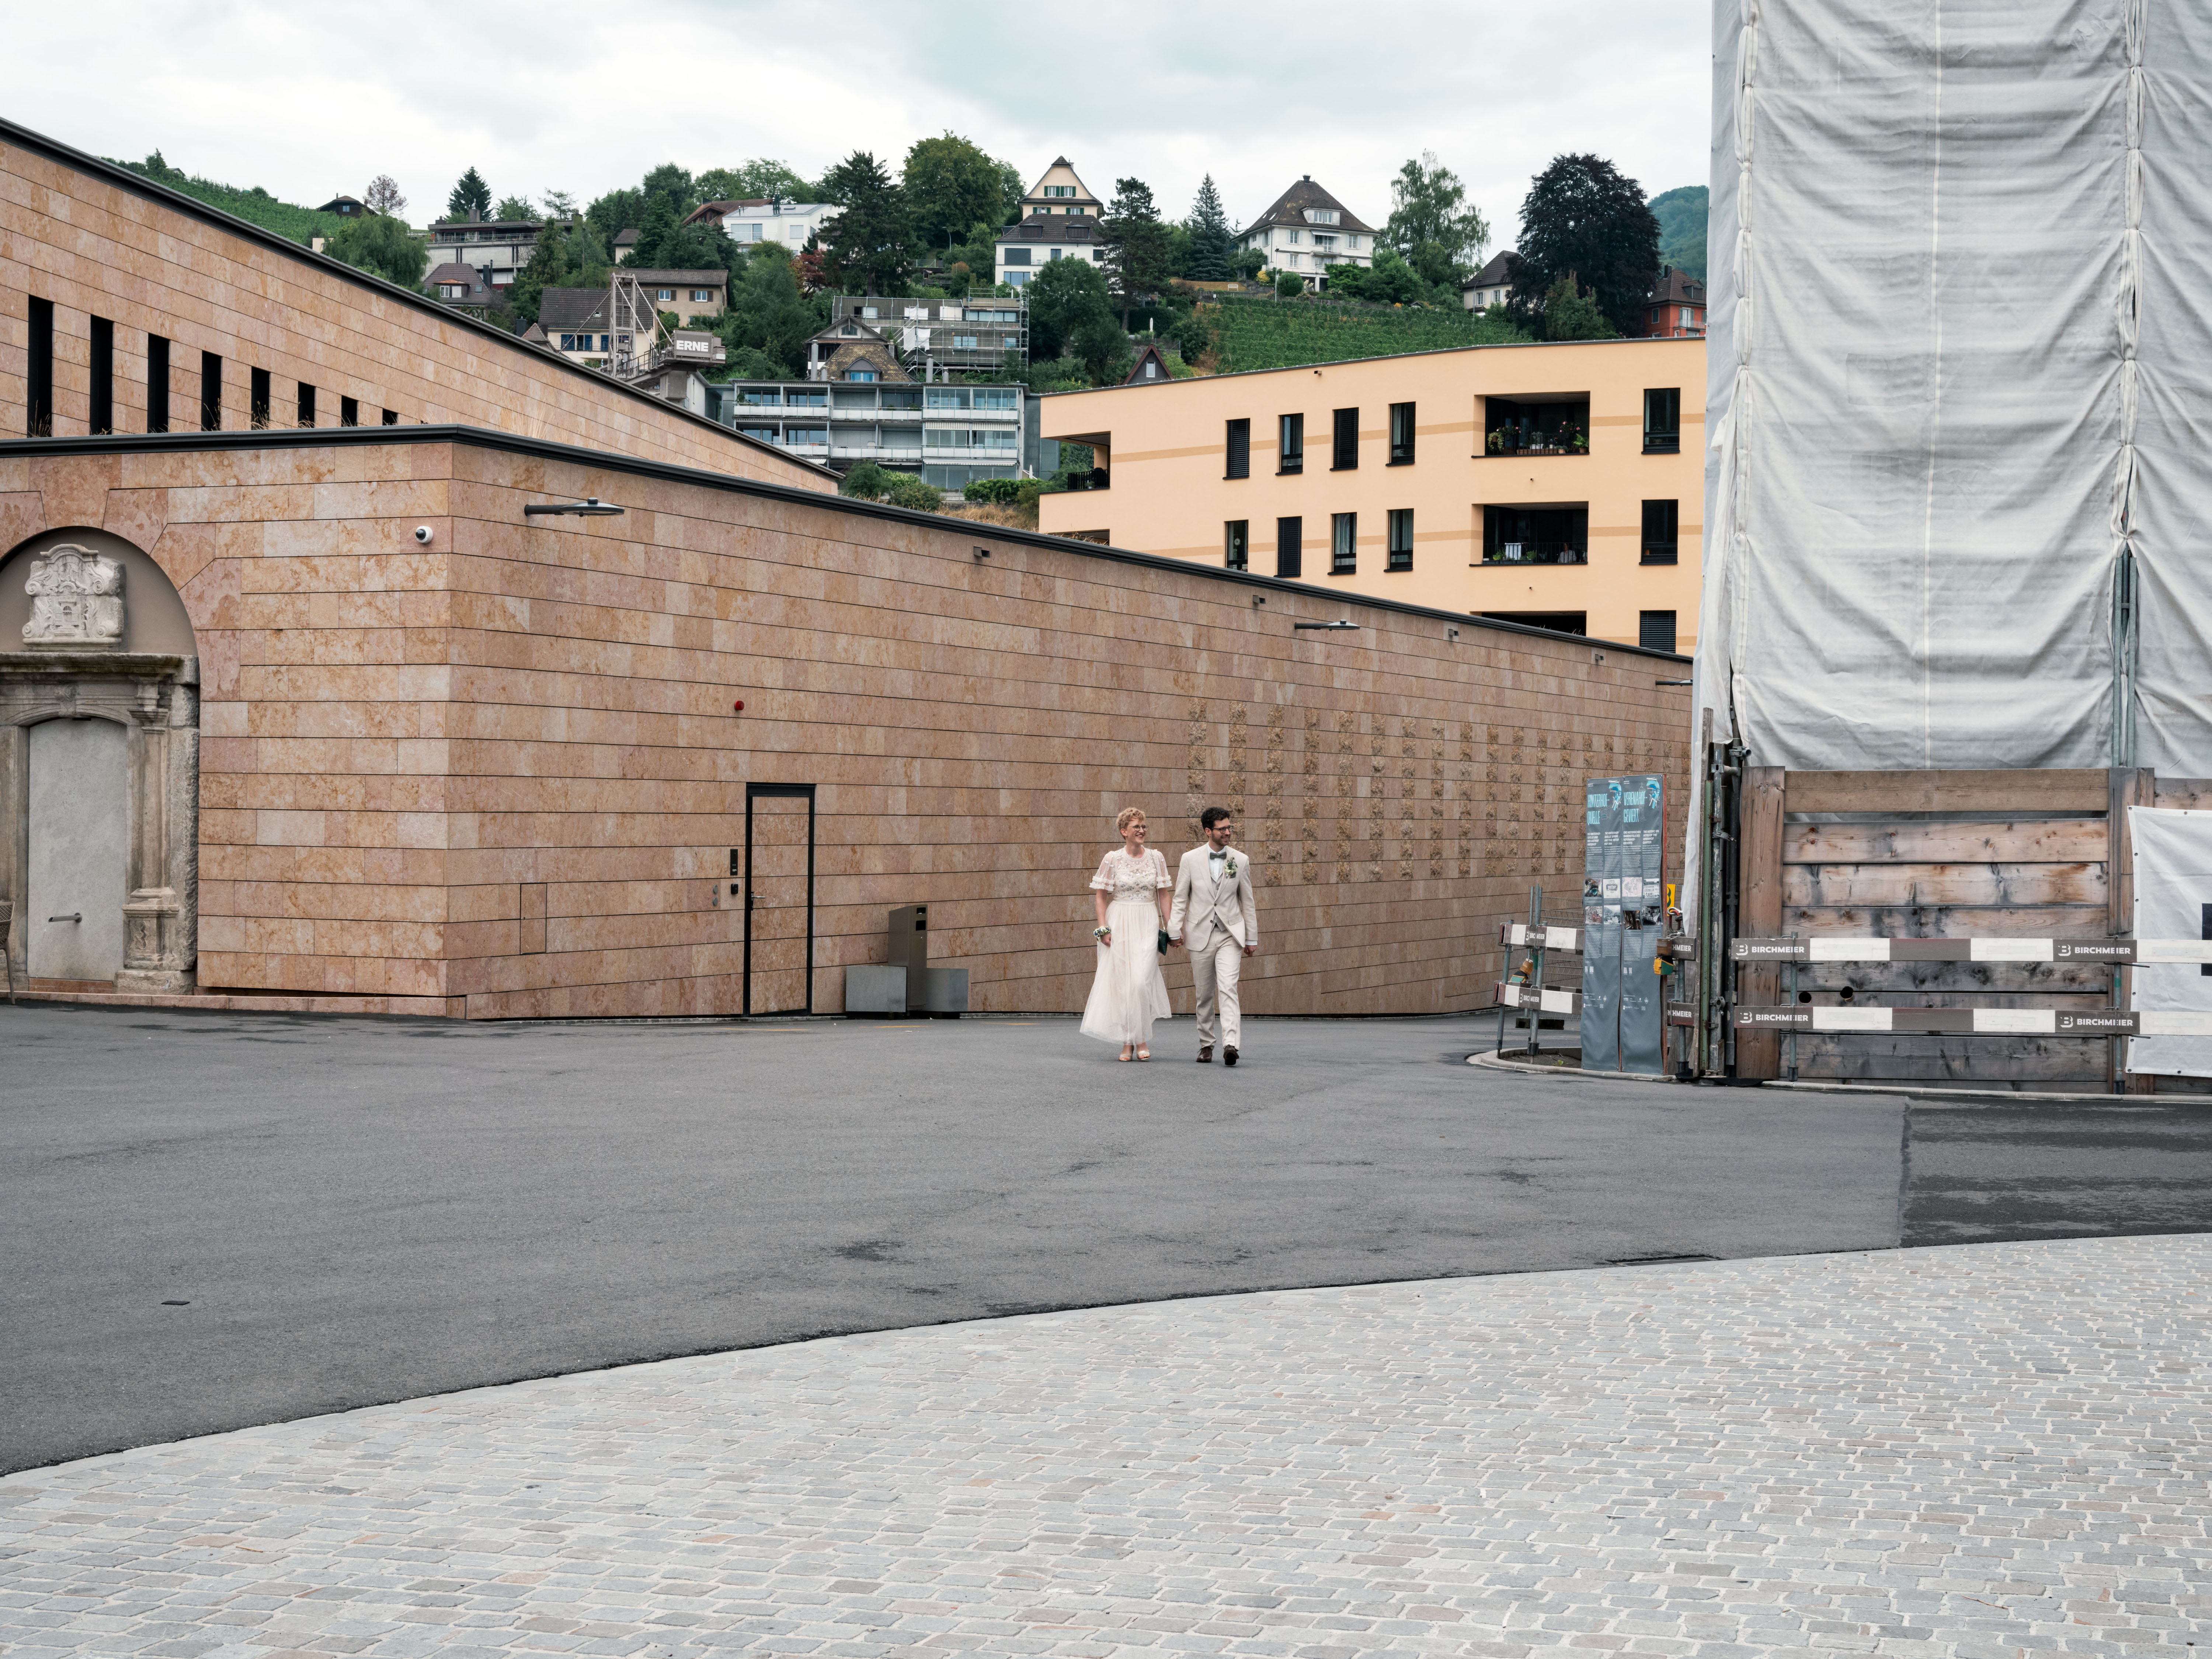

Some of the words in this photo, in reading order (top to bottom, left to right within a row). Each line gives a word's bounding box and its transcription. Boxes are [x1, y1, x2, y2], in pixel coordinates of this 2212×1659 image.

[676, 340, 708, 352] ERNE
[1587, 793, 1610, 808] HINTERHOF-
[1624, 791, 1648, 806] VERENAHOF-
[1587, 811, 1600, 825] QUELLE
[1623, 808, 1639, 823] GEVIERT
